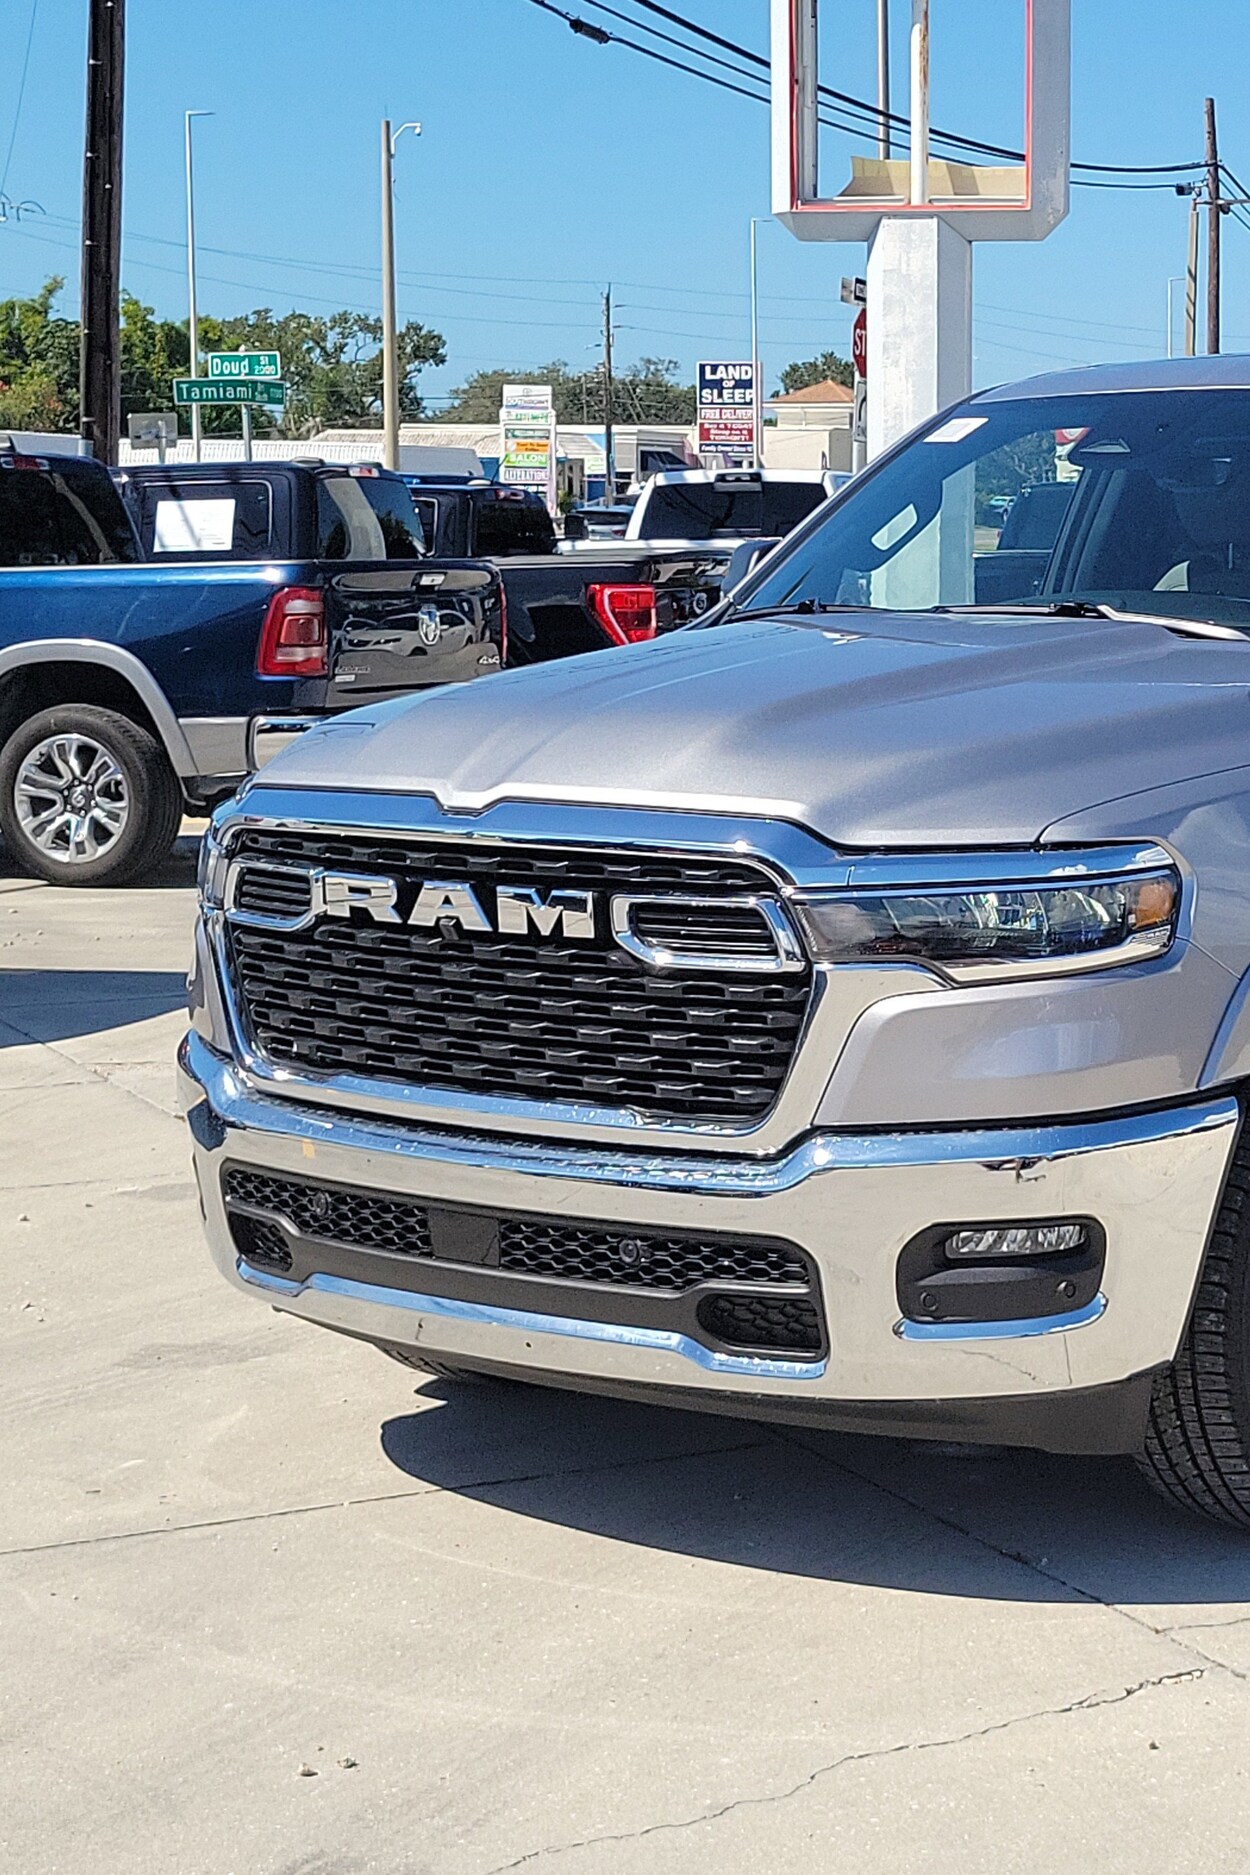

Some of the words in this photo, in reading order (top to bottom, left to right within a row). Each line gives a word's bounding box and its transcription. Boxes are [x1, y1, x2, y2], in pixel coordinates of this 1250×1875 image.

[854, 328, 867, 357] ST
[212, 358, 250, 375] Doud
[705, 365, 753, 380] LAND
[179, 383, 252, 399] Tamiami
[722, 380, 735, 388] OF
[701, 388, 753, 403] SLEEP
[324, 870, 596, 939] RAM
